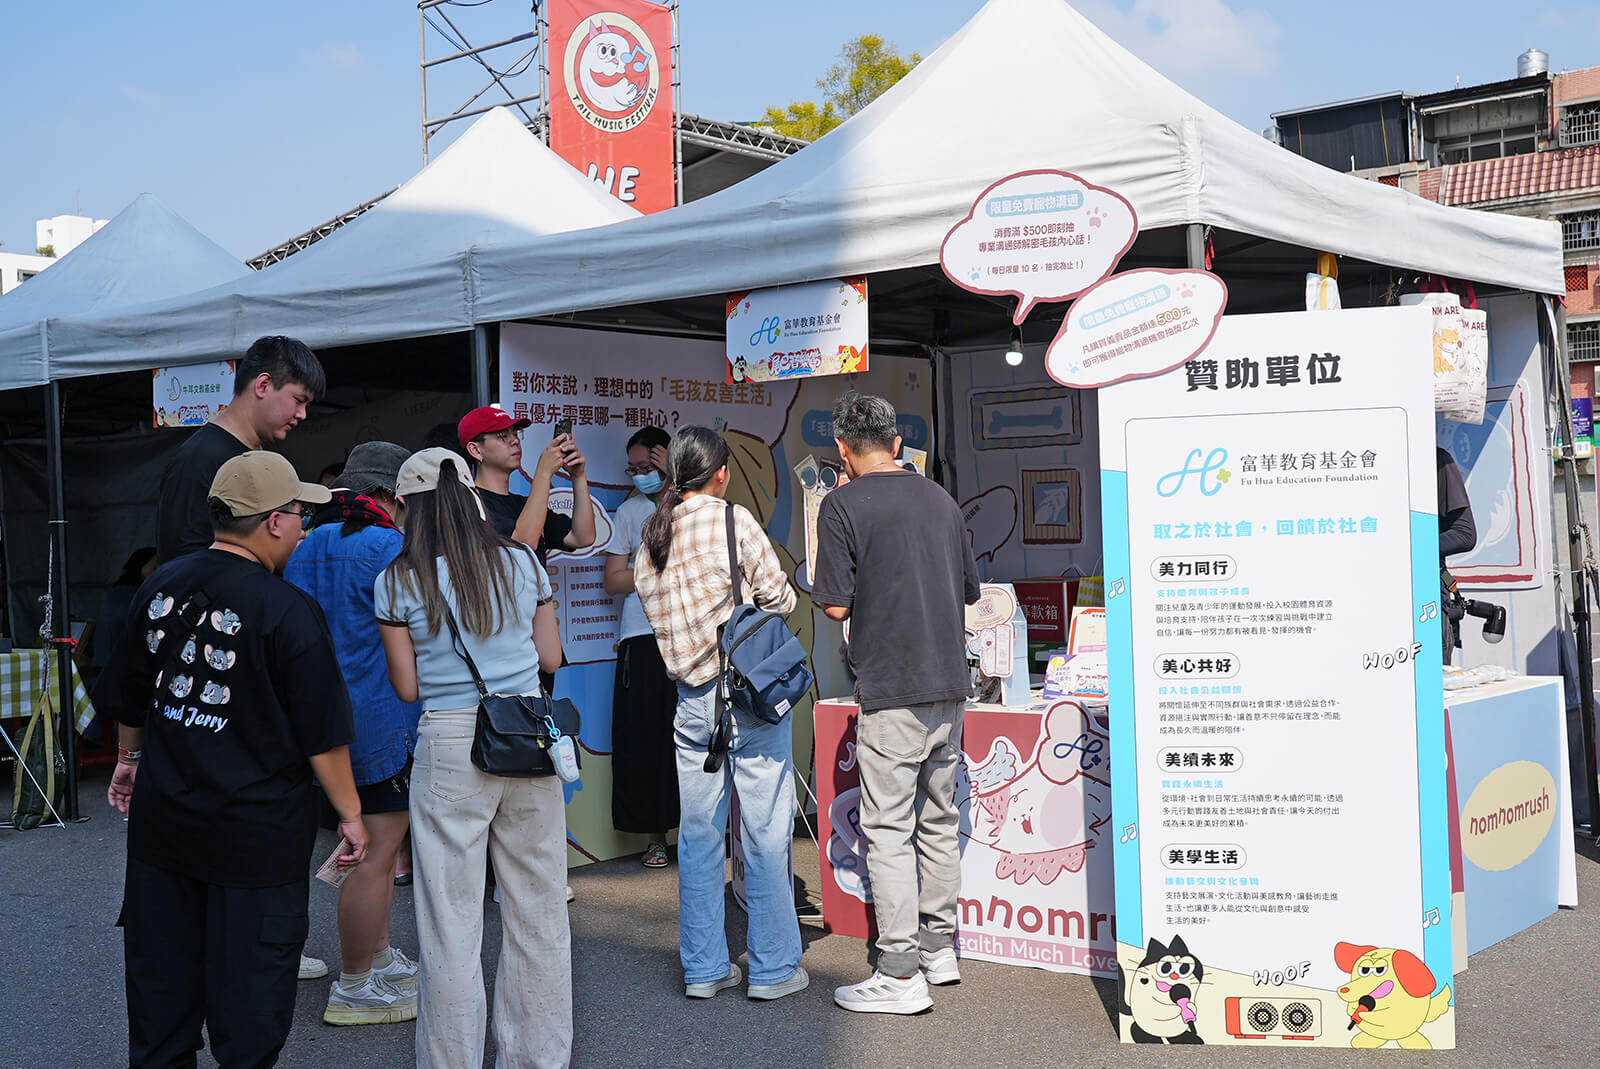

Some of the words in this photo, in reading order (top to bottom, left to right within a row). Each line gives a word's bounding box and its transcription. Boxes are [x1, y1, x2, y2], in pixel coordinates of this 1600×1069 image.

[573, 94, 592, 121] TAIL
[594, 116, 623, 131] MUSIC
[625, 87, 657, 129] FESTIVAL
[994, 226, 1021, 238] 消費滿
[1023, 222, 1075, 237] $500即刻抽
[784, 312, 841, 330] 富華教育基金會
[1185, 353, 1342, 392] 贊助單位
[512, 371, 773, 408] 對你來說，理想中的「毛孩友善生活」
[513, 402, 680, 429] 最優先需要哪一種貼心？
[1240, 449, 1378, 472] 富華教育基金會
[1240, 477, 1253, 486] Fu
[1255, 476, 1274, 486] Hua
[1276, 475, 1322, 485] Education
[1325, 473, 1378, 483] Foundation
[1153, 516, 1378, 540] 取之於社會，回饋於社會
[1159, 561, 1229, 577] 美力同行
[1162, 658, 1232, 674] 美心共好
[1362, 642, 1423, 671] WOOF
[164, 704, 185, 721] and
[185, 707, 228, 733] Jerry
[1165, 752, 1236, 767] 美續未來
[1470, 787, 1550, 836] nomnomrush
[1168, 849, 1239, 865] 美學生活
[1166, 916, 1211, 926] 生活的美好。
[956, 934, 1004, 955] ealth
[1011, 938, 1064, 964] Much
[1072, 947, 1117, 971] Love
[1252, 961, 1311, 988] WOOF
